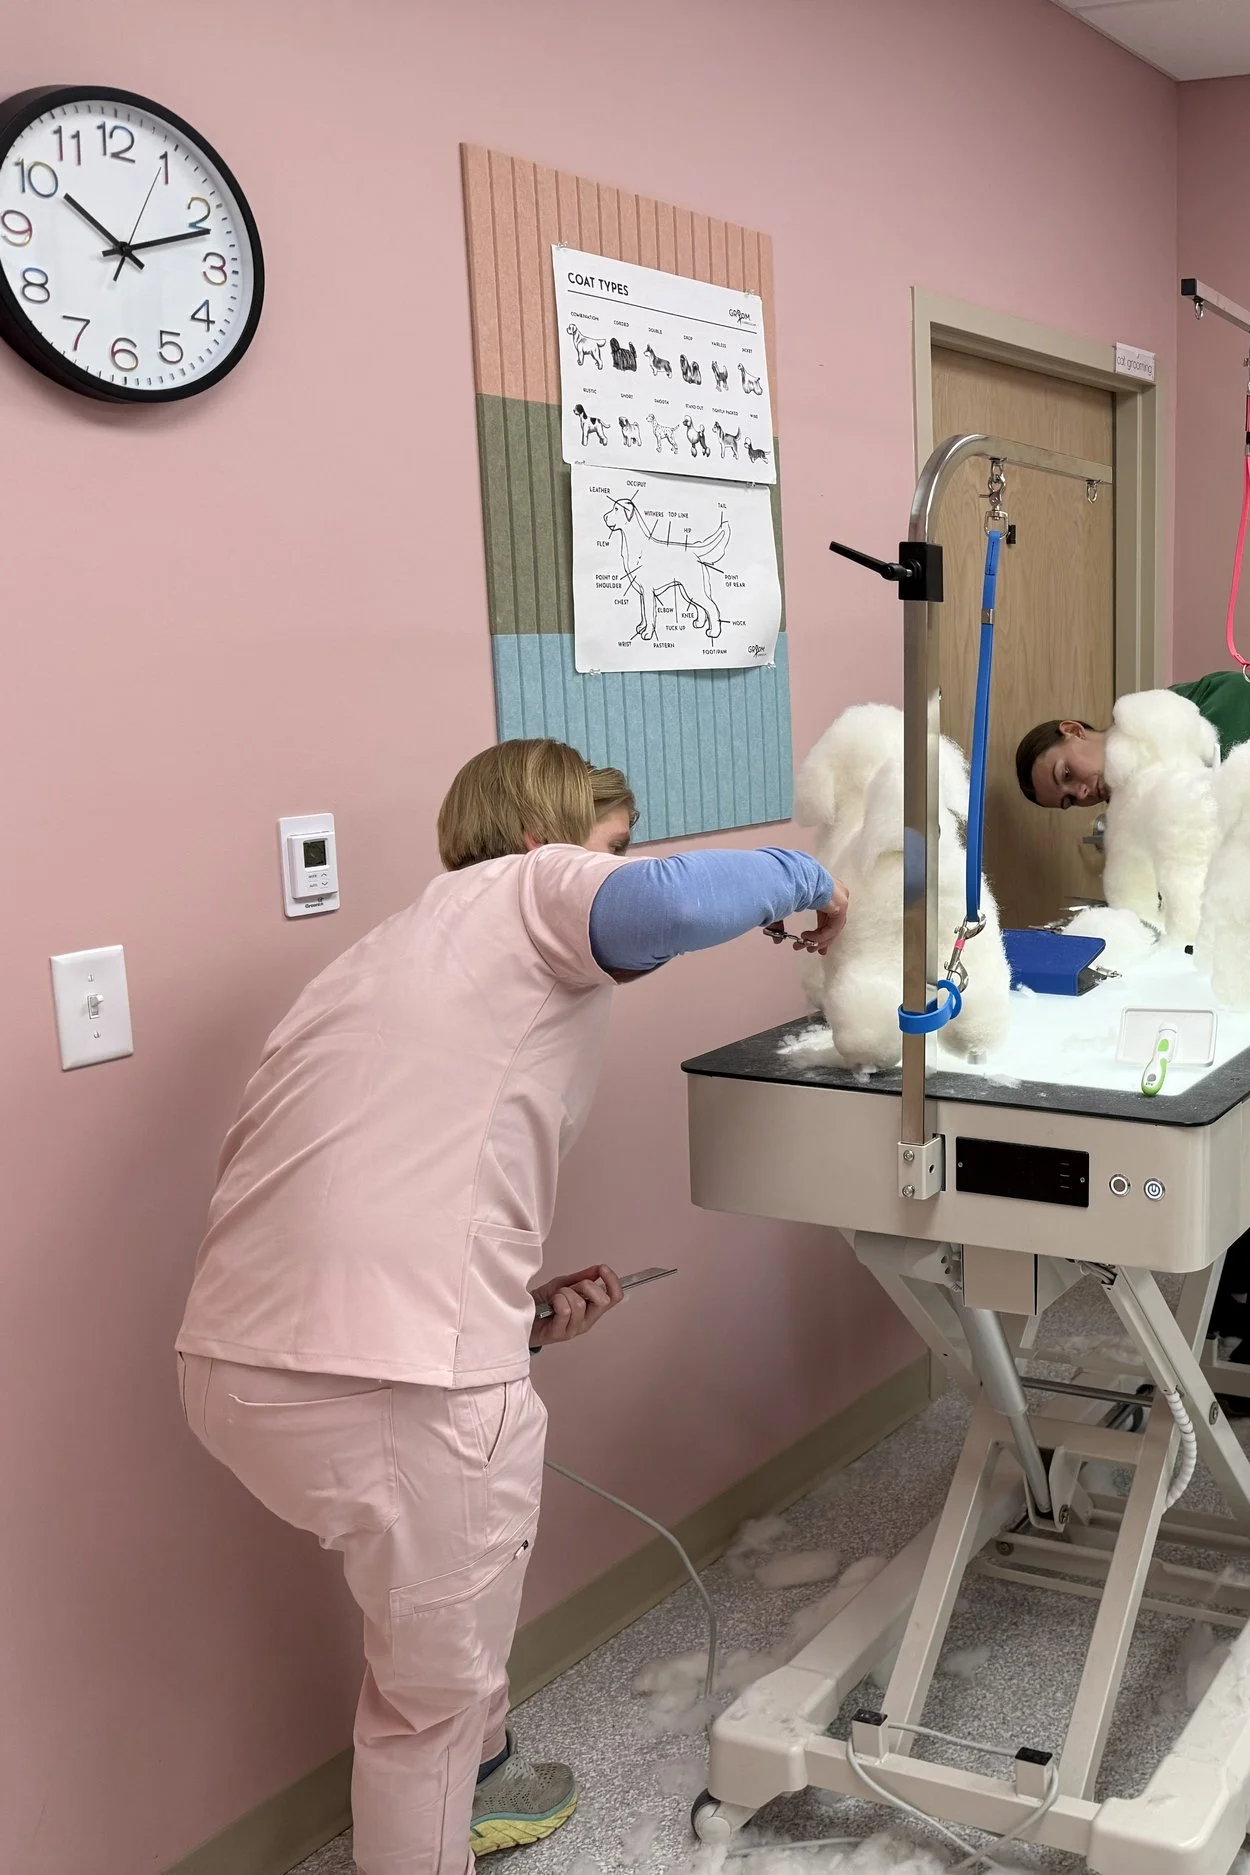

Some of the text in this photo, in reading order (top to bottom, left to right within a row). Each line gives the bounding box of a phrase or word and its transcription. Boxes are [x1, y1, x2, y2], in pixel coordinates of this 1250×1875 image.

[53, 125, 82, 166] 11
[96, 120, 136, 163] 12
[14, 157, 59, 199] 10
[159, 150, 169, 185] 1
[1, 209, 33, 247] 9
[187, 196, 211, 232] 2
[21, 267, 51, 304] 8
[202, 252, 228, 286] 3
[567, 272, 629, 296] COAT TYPES
[62, 314, 91, 352] 7
[190, 299, 216, 333] 4
[110, 337, 139, 372] 6
[158, 329, 184, 365] 5
[589, 486, 611, 494] LEATHER
[626, 480, 647, 488] OCCIPUT
[644, 510, 664, 518] WITHERS
